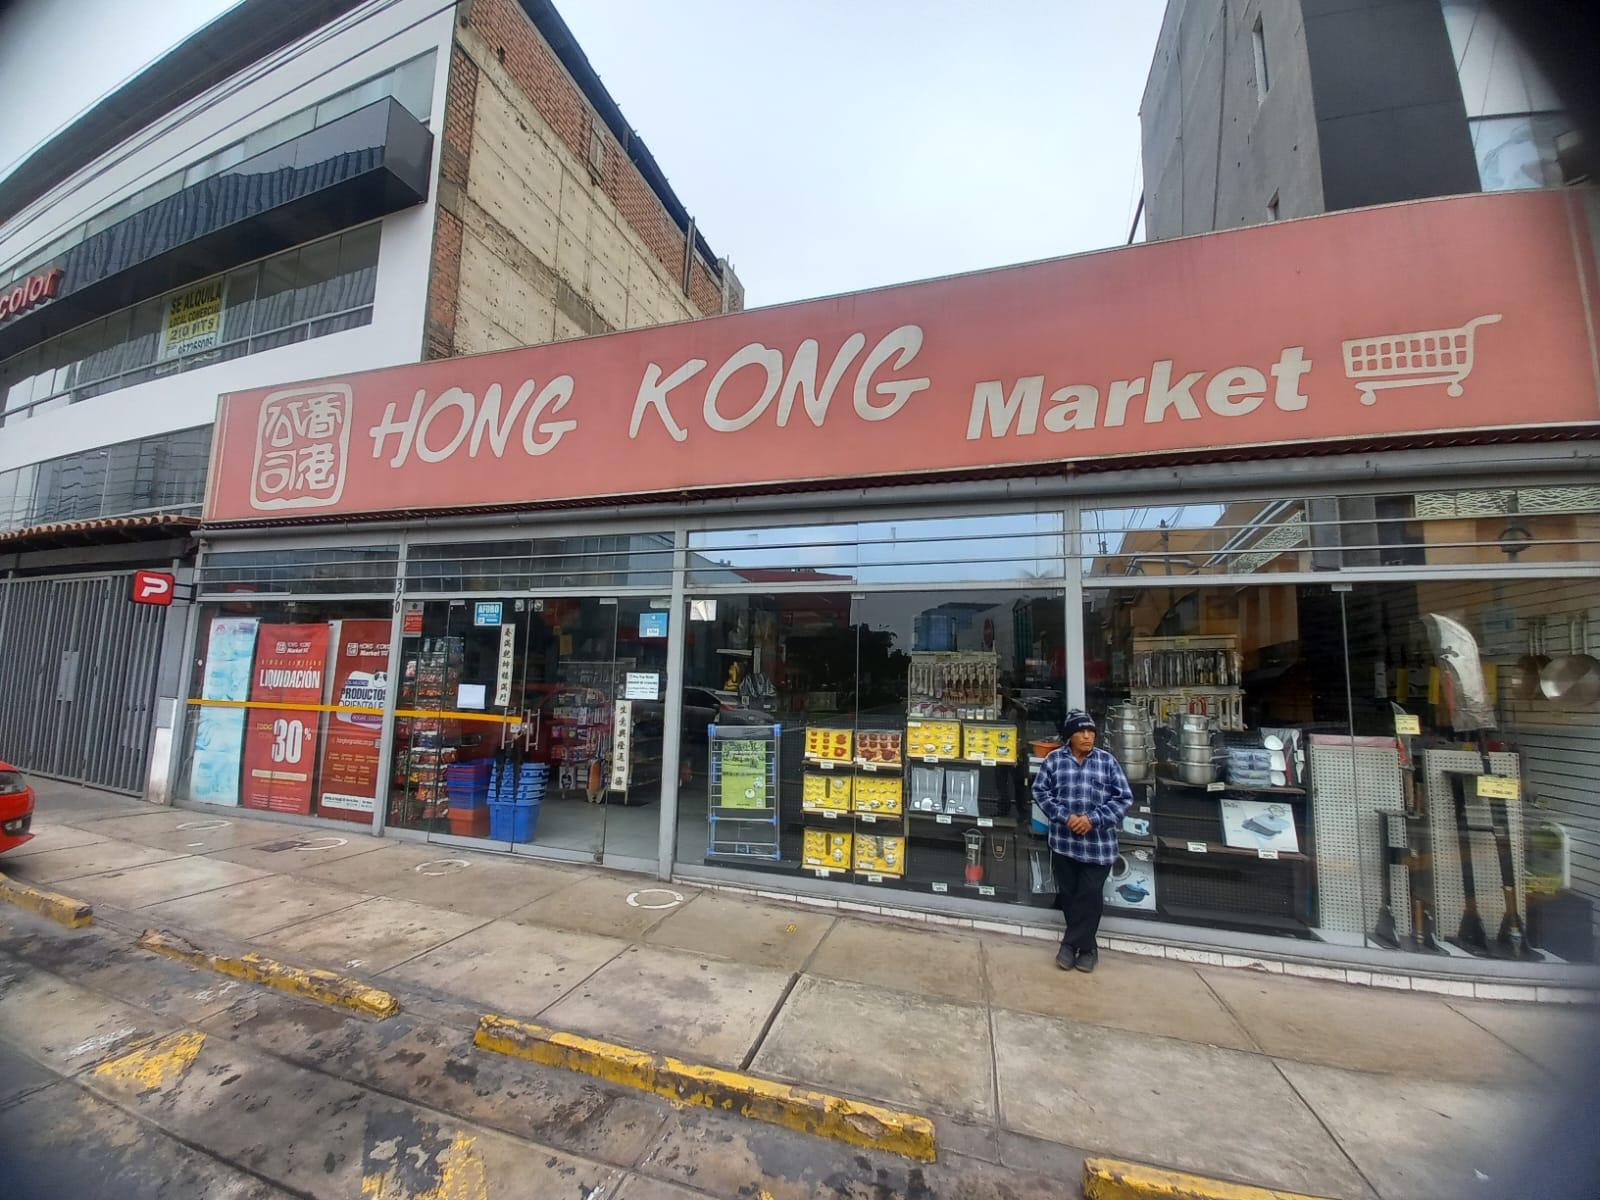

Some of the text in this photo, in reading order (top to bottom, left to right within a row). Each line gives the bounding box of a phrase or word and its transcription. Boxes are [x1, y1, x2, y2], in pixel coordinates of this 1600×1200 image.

[369, 324, 1312, 468] HONG KONG Market
[260, 666, 321, 690] LIQUIDACIÓN
